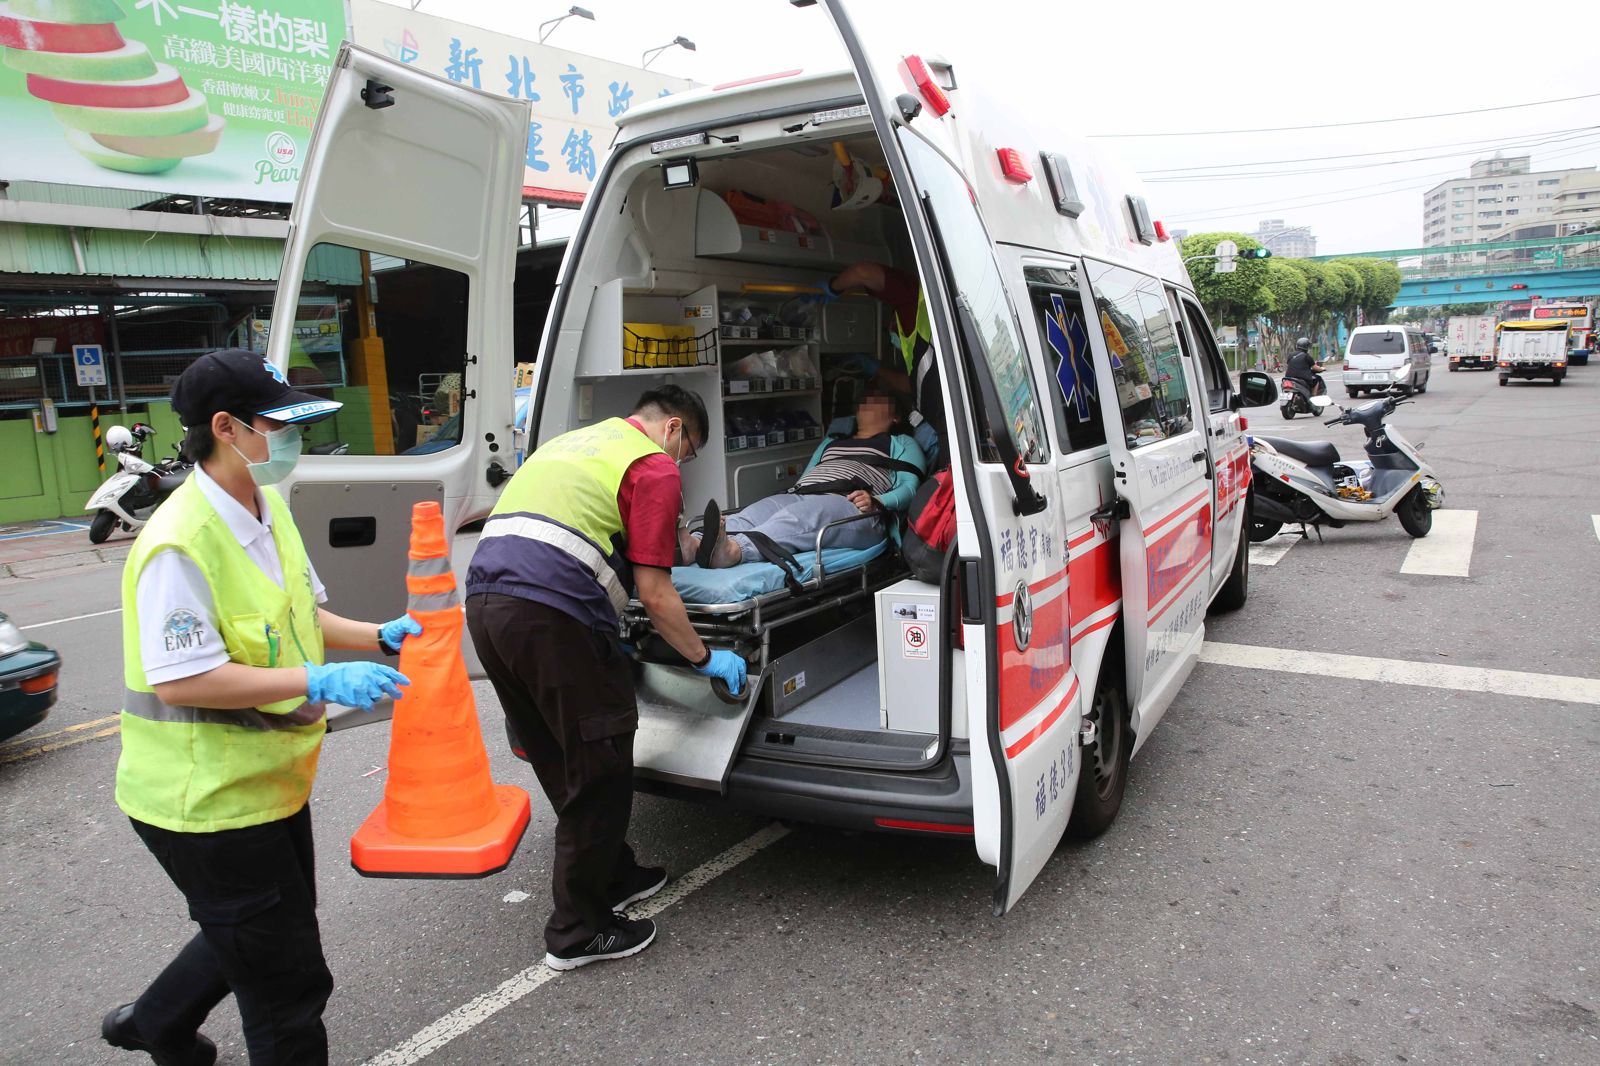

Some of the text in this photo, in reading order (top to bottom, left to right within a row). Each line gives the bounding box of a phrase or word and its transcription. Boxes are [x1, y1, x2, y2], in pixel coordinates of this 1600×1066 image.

[444, 37, 675, 118] 新北市政
[291, 404, 325, 416] EMS
[165, 630, 204, 651] EMT
[910, 630, 922, 643] 油
